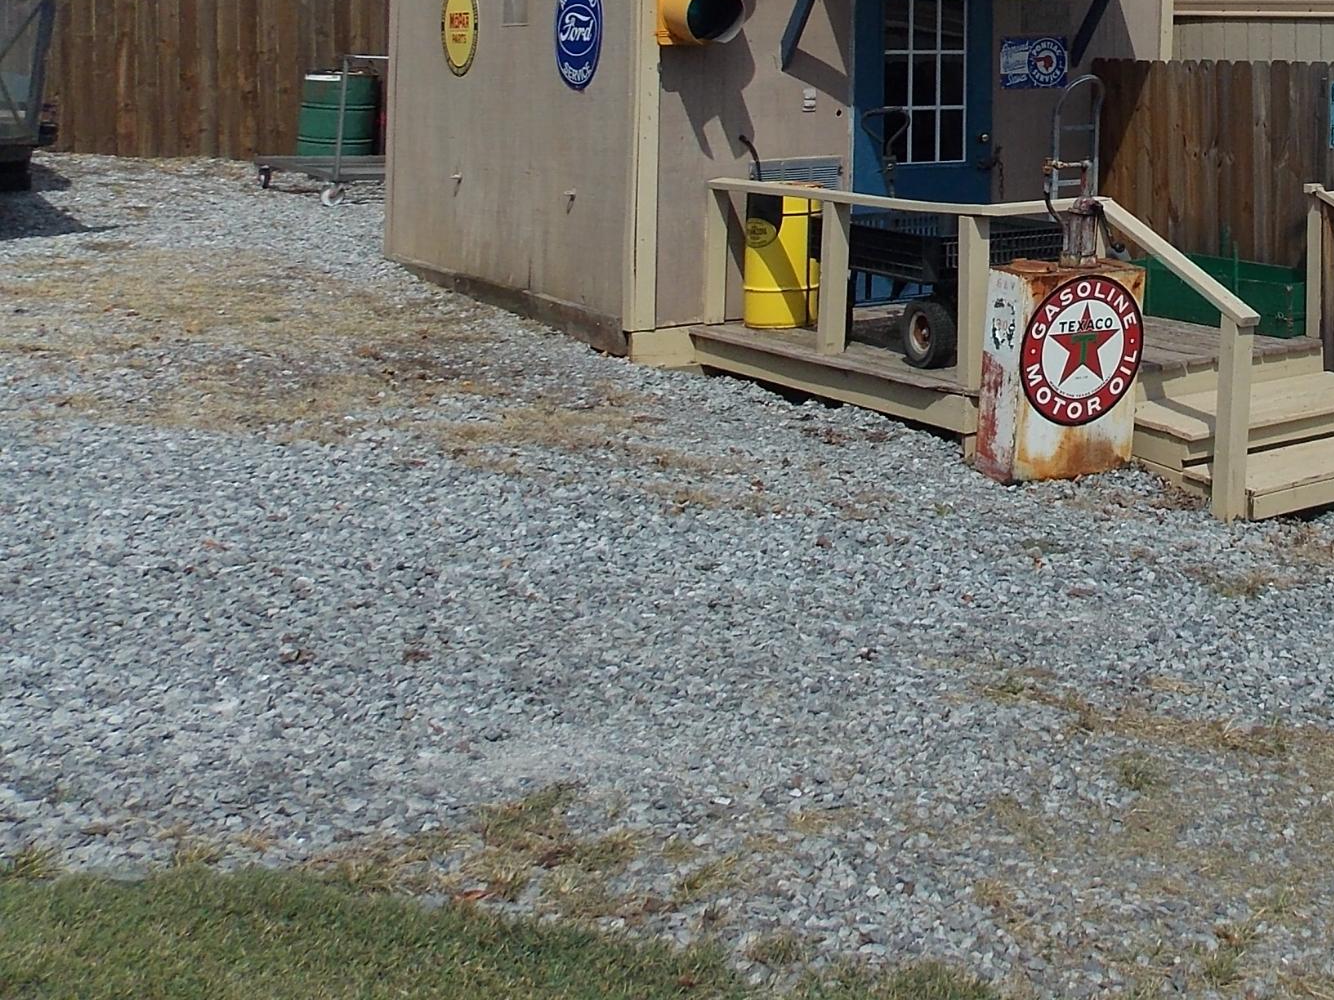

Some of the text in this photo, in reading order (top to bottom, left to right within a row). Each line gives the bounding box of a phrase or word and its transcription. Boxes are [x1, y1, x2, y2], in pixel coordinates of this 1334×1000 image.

[560, 12, 594, 41] Ford
[1031, 41, 1062, 56] PONTIAC
[563, 61, 593, 81] SERVICE
[1031, 68, 1061, 83] SERVICE
[1031, 282, 1137, 340] GASOLINE
[1059, 317, 1113, 333] TEXACO
[1026, 363, 1102, 419] MOTOR
[1109, 350, 1138, 394] OIL
